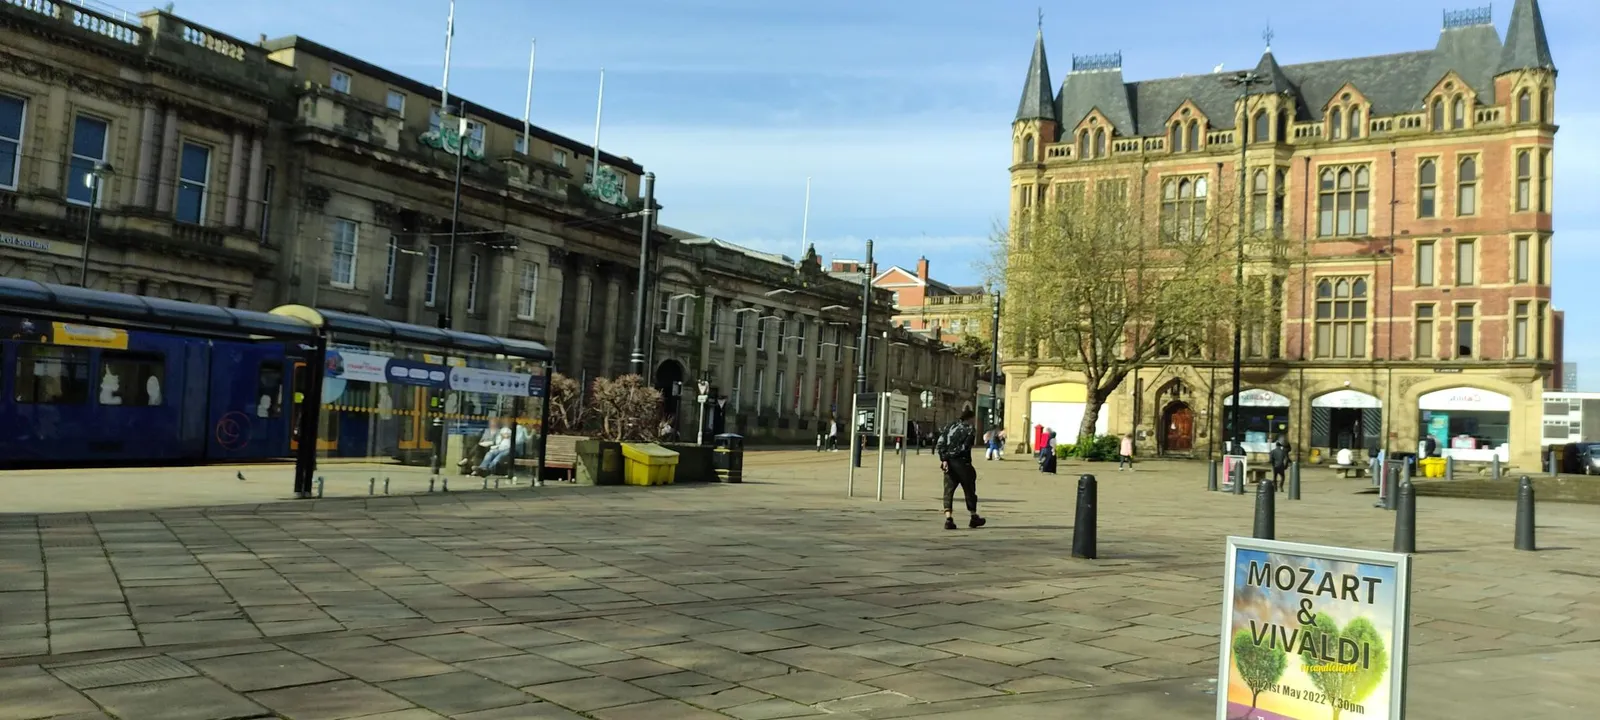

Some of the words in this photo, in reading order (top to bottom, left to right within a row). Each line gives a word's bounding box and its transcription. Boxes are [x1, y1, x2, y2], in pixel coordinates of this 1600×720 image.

[1247, 561, 1382, 604] MOZART
[1296, 597, 1318, 627] &
[1250, 619, 1370, 670] VIVALDI
[1310, 662, 1357, 674] candlelight
[1261, 680, 1281, 694] 21st
[1282, 685, 1301, 700] May
[1302, 689, 1326, 705] 2022
[1330, 696, 1365, 715] 7.30pm
